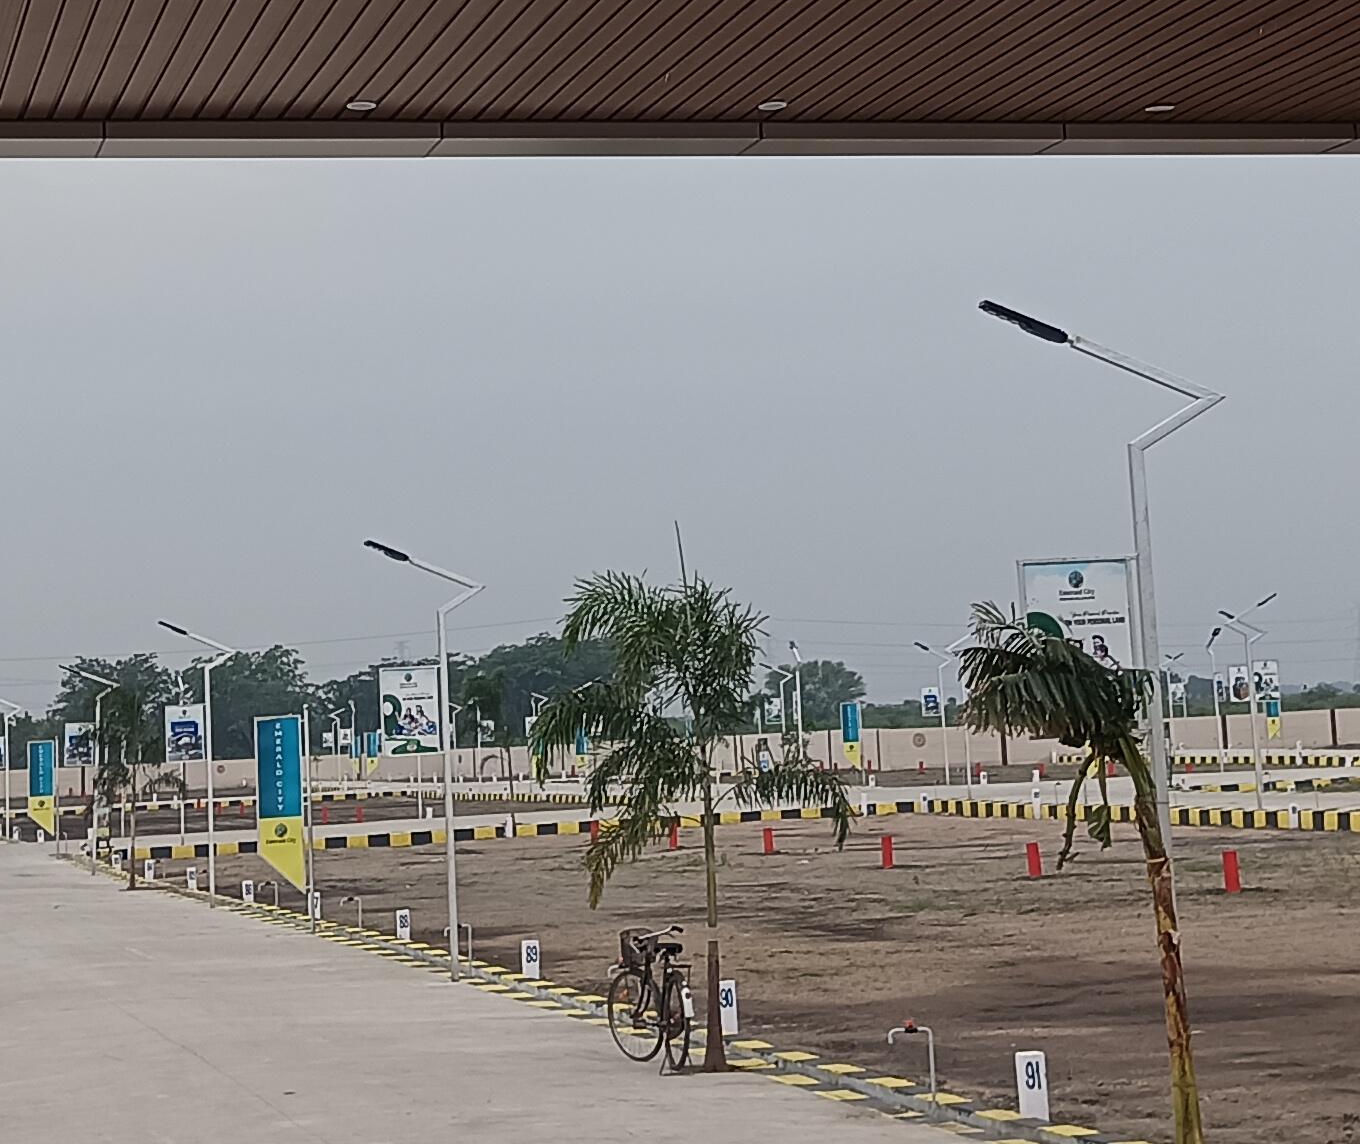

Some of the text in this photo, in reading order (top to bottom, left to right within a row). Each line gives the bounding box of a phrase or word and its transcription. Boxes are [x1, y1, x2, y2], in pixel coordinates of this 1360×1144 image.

[274, 722, 283, 777] EMERALD
[526, 945, 538, 964] 89
[720, 987, 734, 1008] 90
[1025, 1060, 1042, 1091] 91
